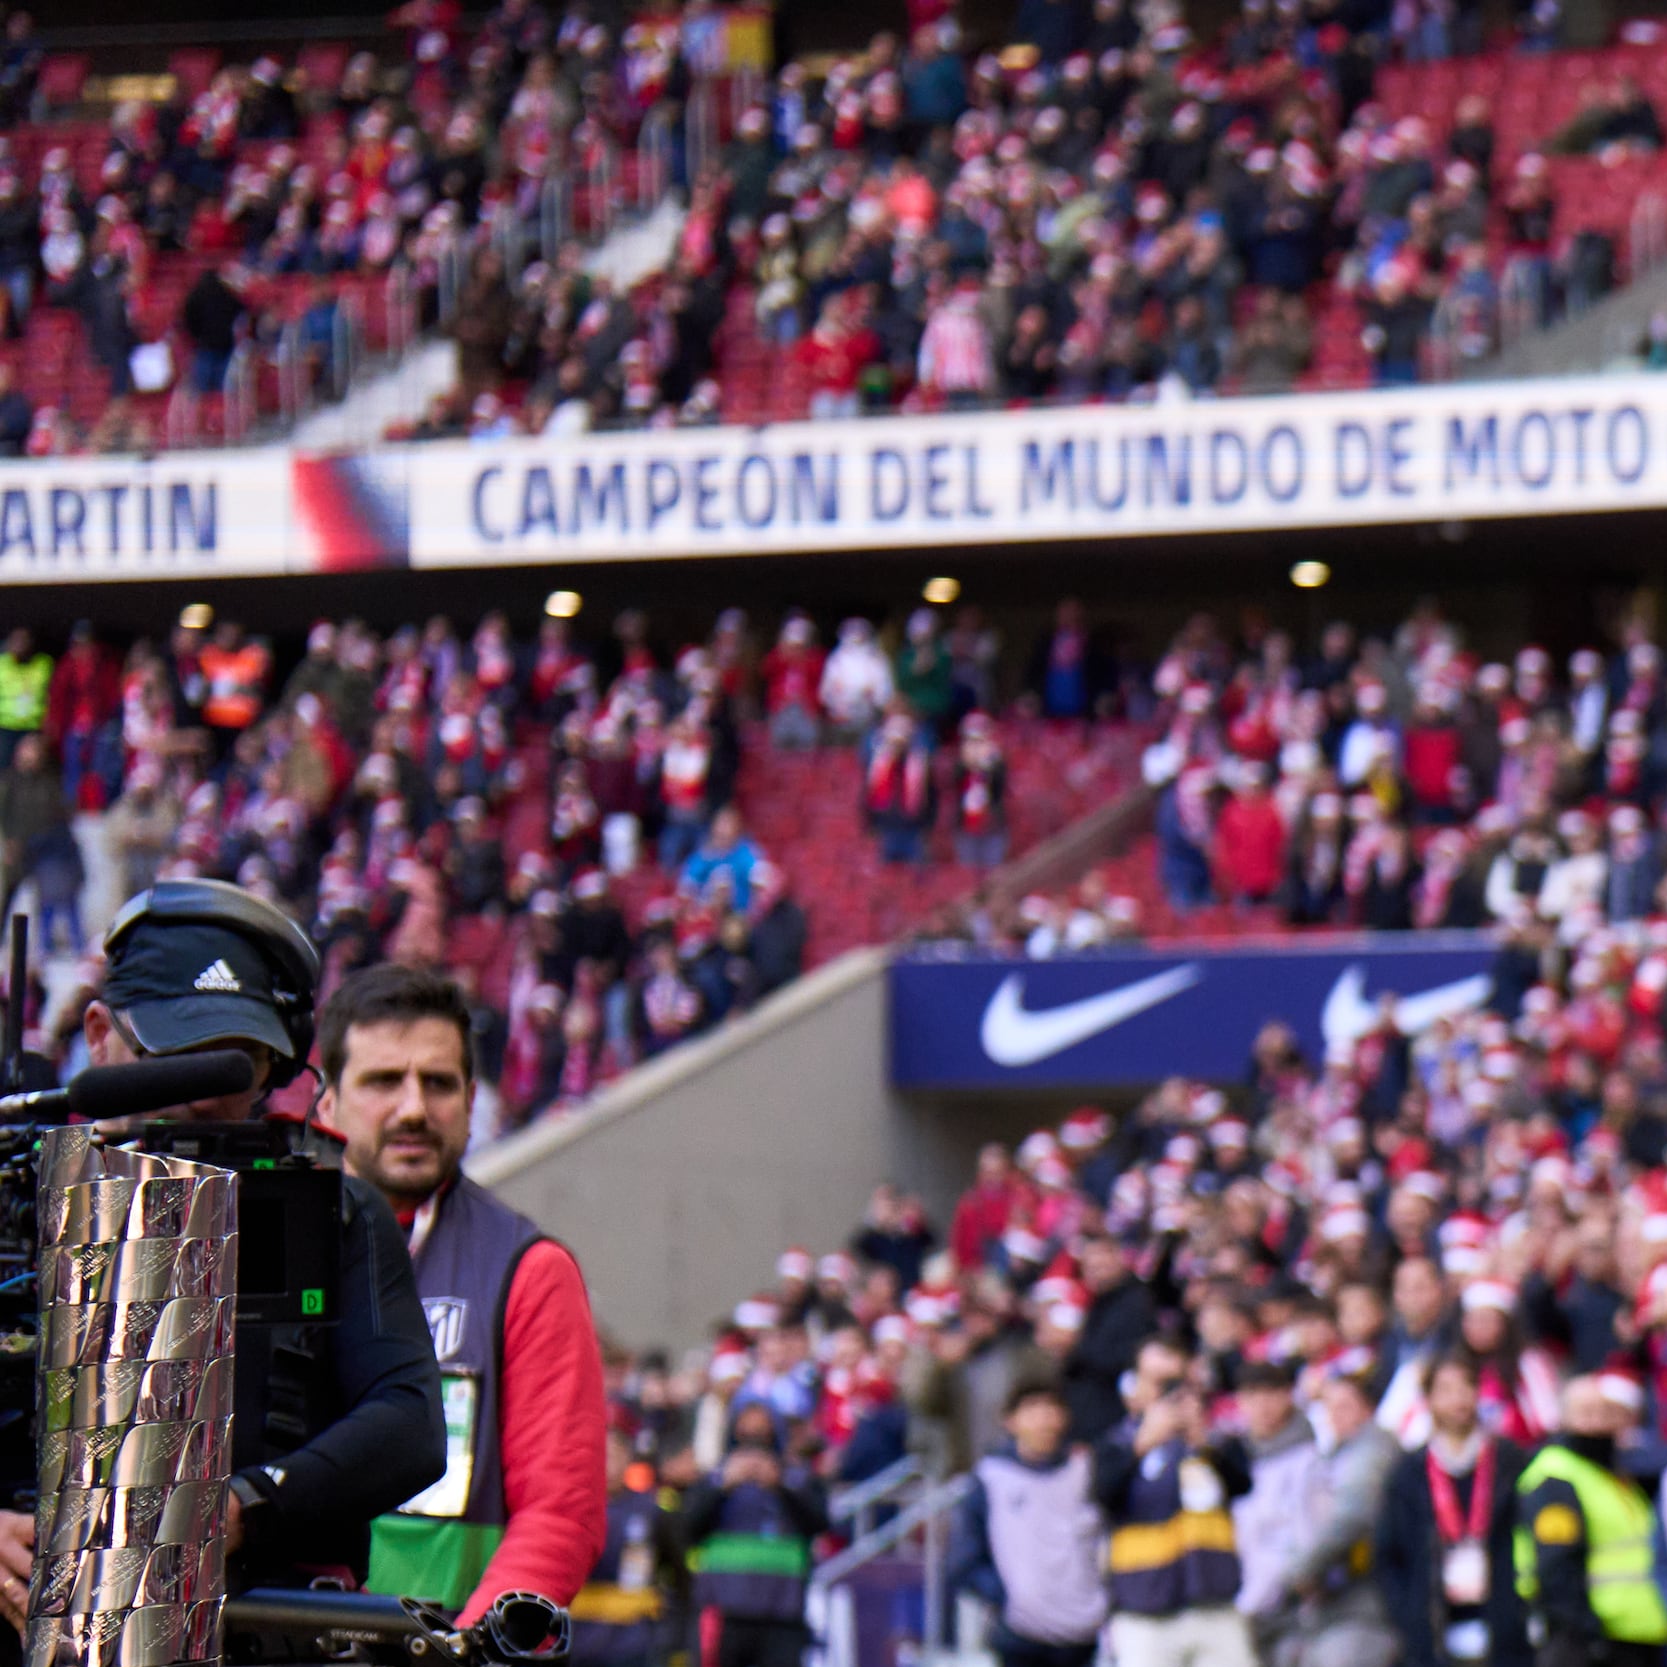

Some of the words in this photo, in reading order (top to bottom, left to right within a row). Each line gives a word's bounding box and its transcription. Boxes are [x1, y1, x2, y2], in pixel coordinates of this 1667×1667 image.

[870, 444, 990, 523] DEL
[1019, 424, 1307, 512] MUNDO
[1333, 420, 1415, 499] DE
[1445, 406, 1650, 490] MOTO
